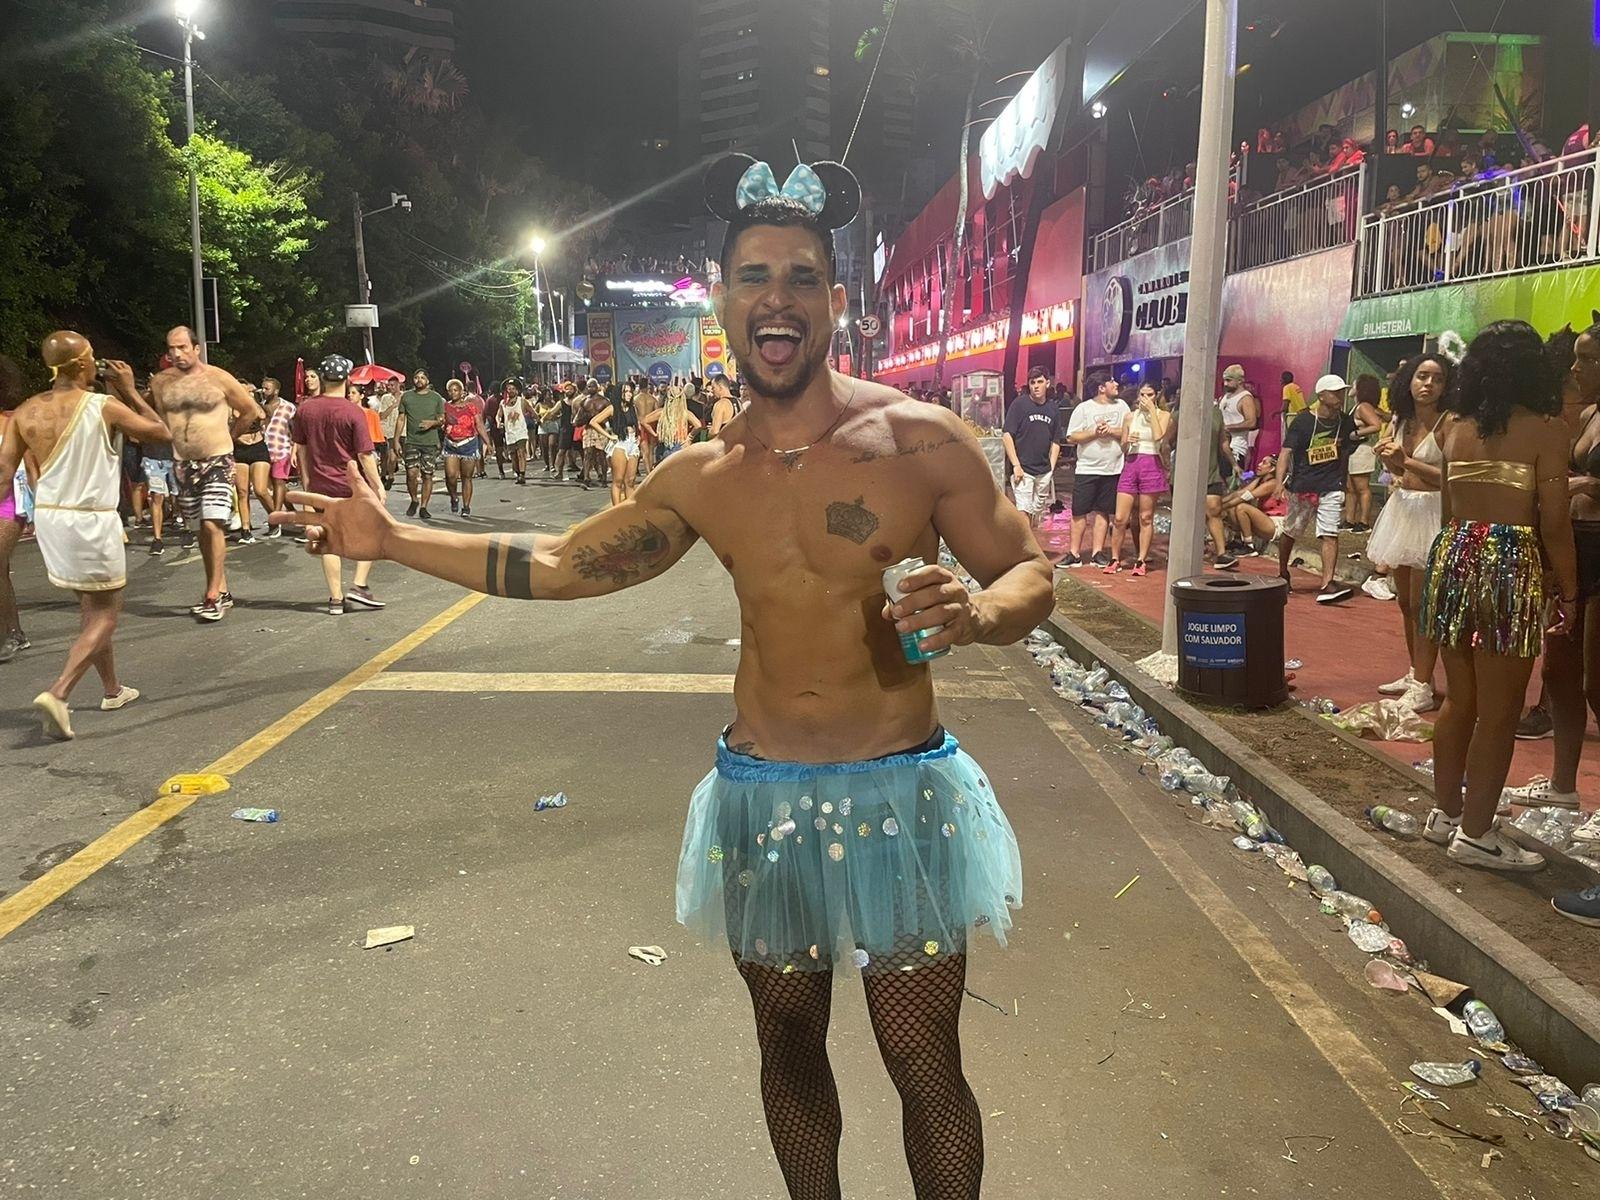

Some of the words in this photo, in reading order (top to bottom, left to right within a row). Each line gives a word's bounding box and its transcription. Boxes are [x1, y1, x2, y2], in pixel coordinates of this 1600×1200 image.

[1136, 293, 1183, 330] CLUB
[862, 320, 879, 331] 50
[1363, 319, 1411, 335] BILHETERIA
[656, 346, 677, 355] 2023
[1311, 451, 1335, 463] PERIGO
[1188, 622, 1209, 632] JOGUE
[1210, 624, 1237, 633] LIMPO
[1184, 633, 1200, 643] COM
[1201, 635, 1242, 645] SALVADOR
